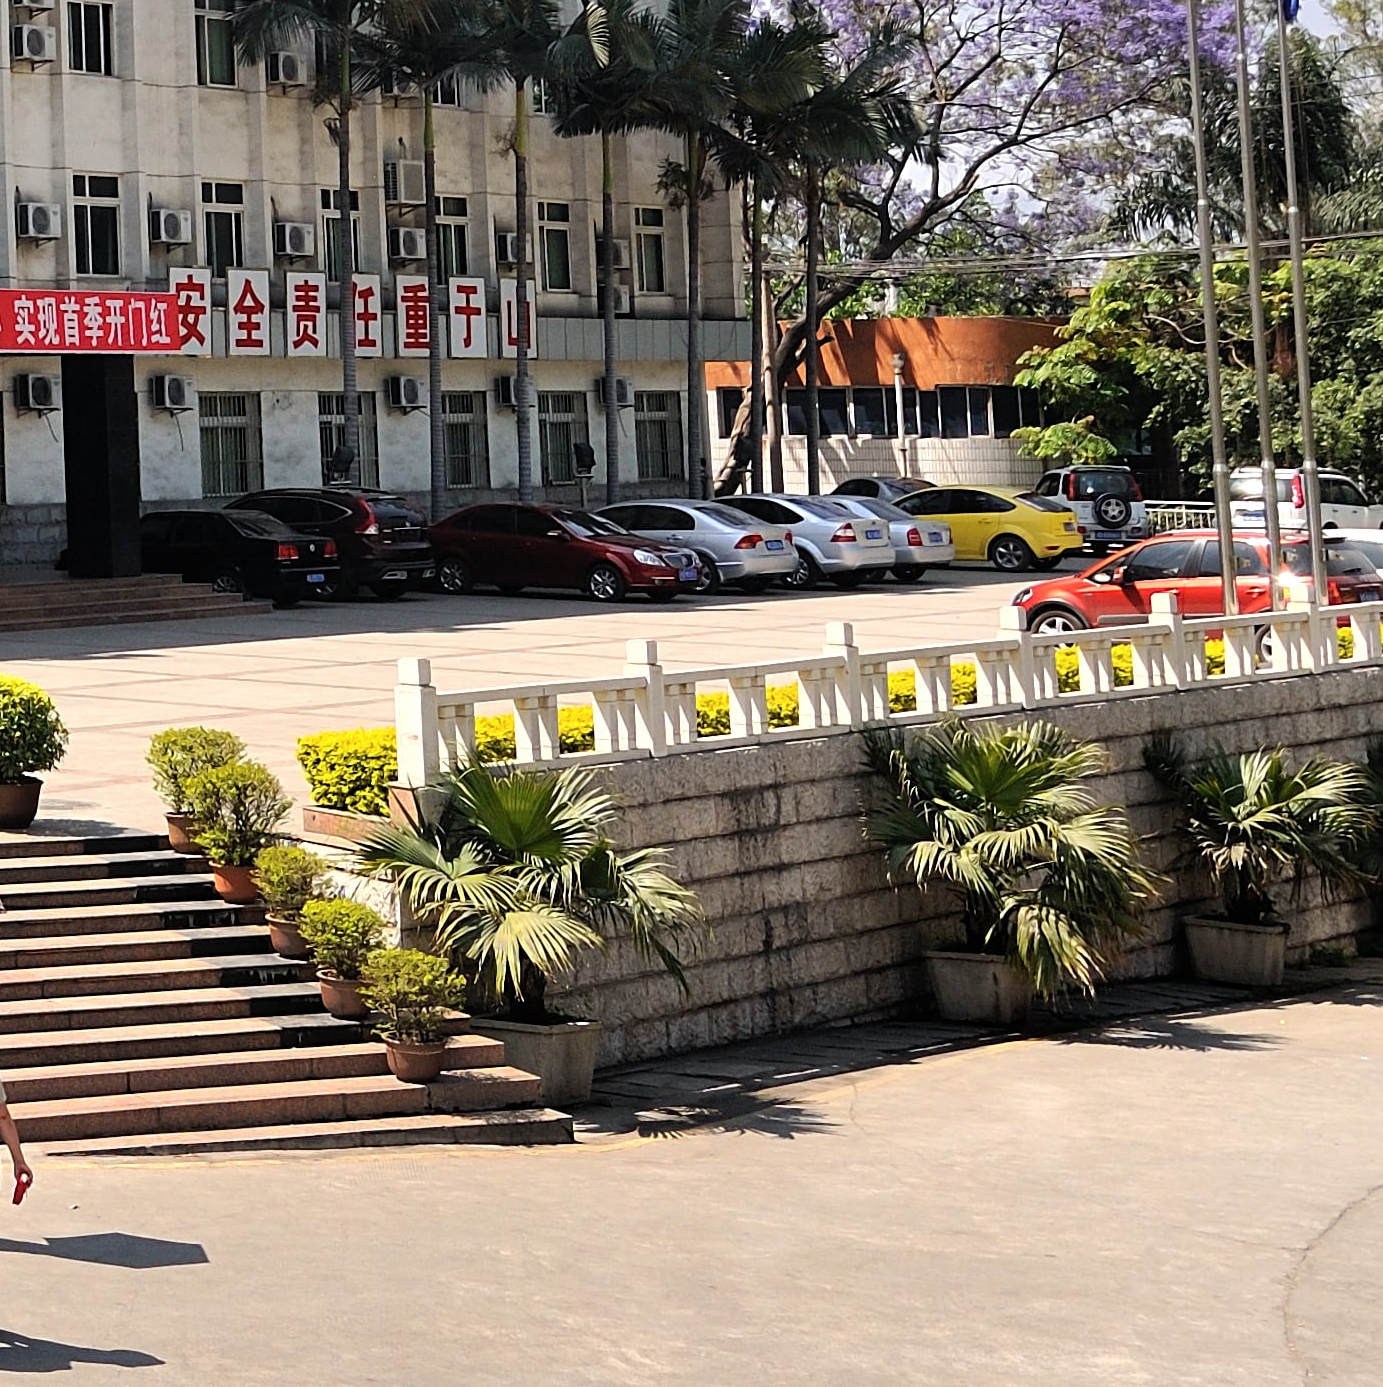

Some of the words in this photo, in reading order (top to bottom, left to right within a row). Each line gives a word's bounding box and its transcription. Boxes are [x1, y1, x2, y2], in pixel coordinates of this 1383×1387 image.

[14, 294, 171, 348] 实现首季开门红
[177, 273, 531, 350] 安全责任重于山
